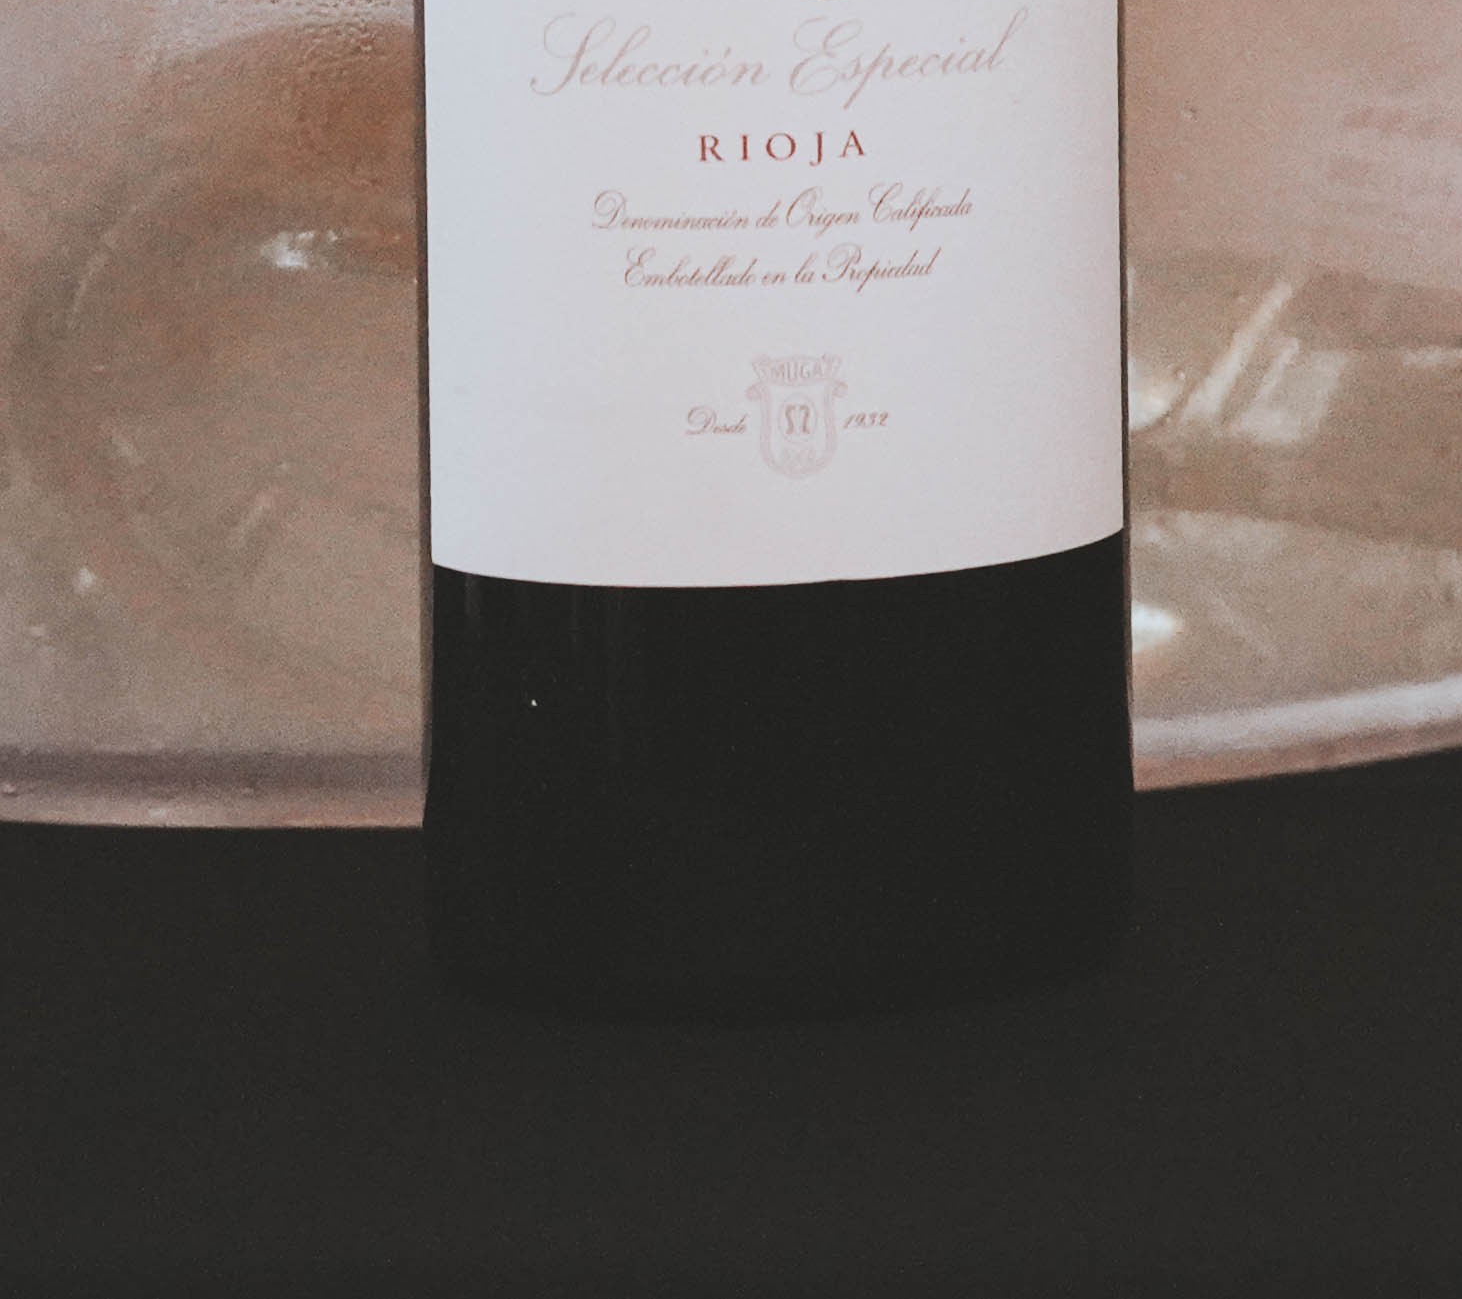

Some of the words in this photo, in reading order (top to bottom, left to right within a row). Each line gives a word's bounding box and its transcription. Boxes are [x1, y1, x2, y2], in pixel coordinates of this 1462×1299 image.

[530, 12, 771, 96] Selección
[789, 5, 1029, 110] Especial
[697, 129, 867, 167] RIOJA
[755, 198, 782, 229] de
[785, 185, 860, 240] Origen
[760, 268, 786, 287] en
[795, 250, 817, 285] la
